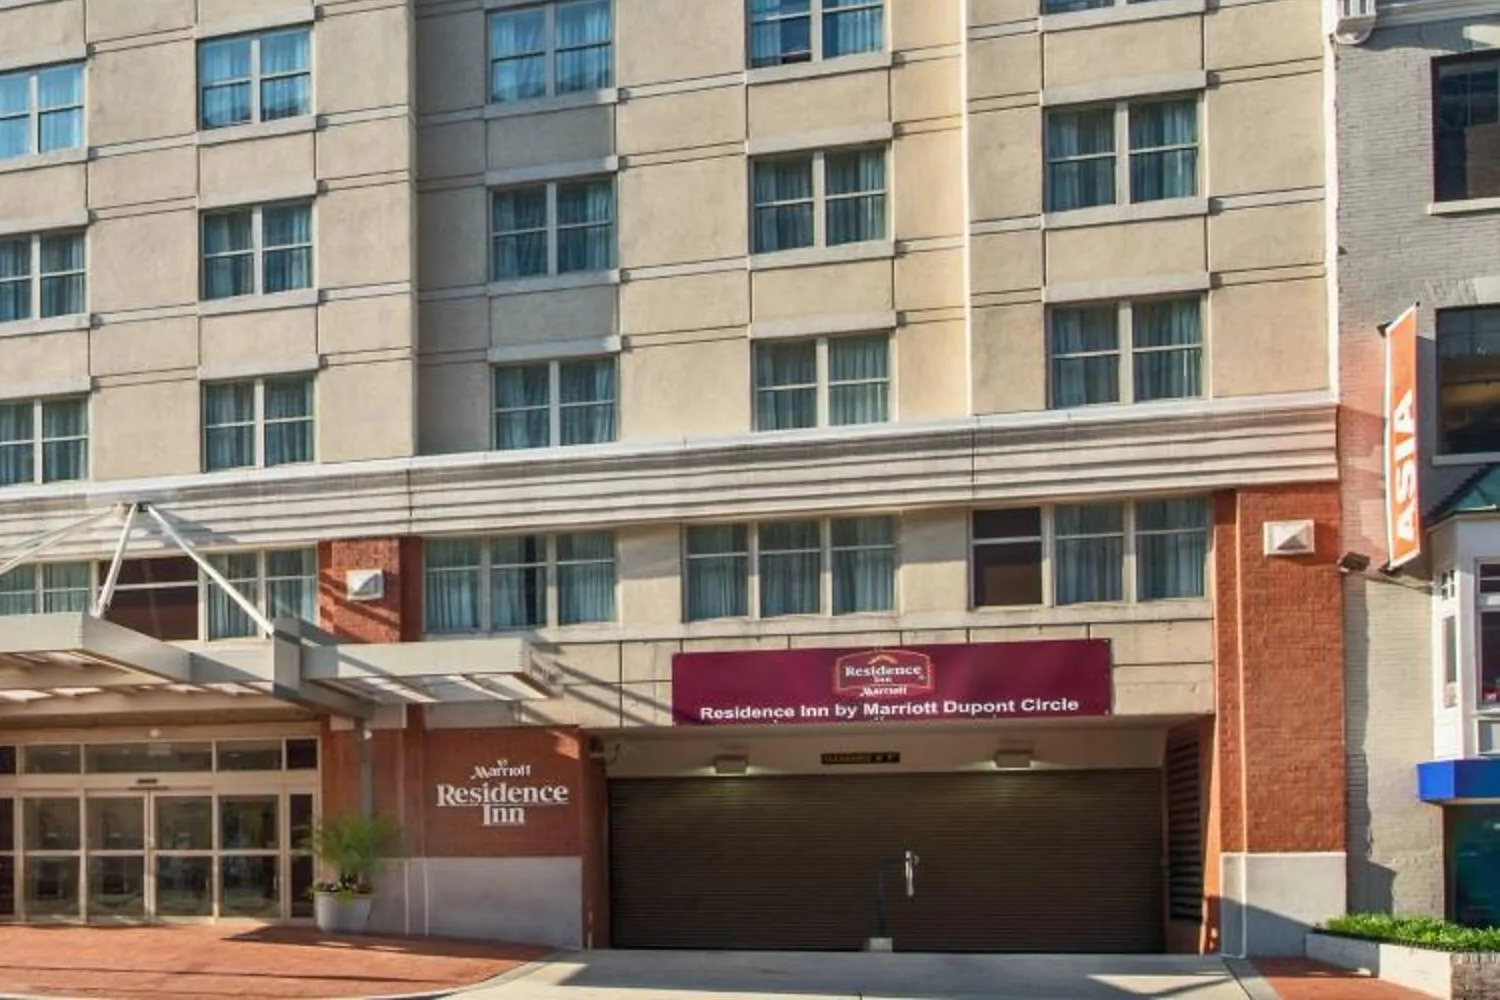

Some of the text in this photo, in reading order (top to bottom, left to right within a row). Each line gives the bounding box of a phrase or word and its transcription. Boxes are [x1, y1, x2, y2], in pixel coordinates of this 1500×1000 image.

[1393, 388, 1417, 541] ASIA
[844, 665, 923, 677] Residence
[700, 697, 1080, 720] Residence Inn by Marriott Dupont Circle
[470, 764, 531, 779] Marriott
[436, 782, 569, 807] Residence
[482, 804, 526, 826] Inn
